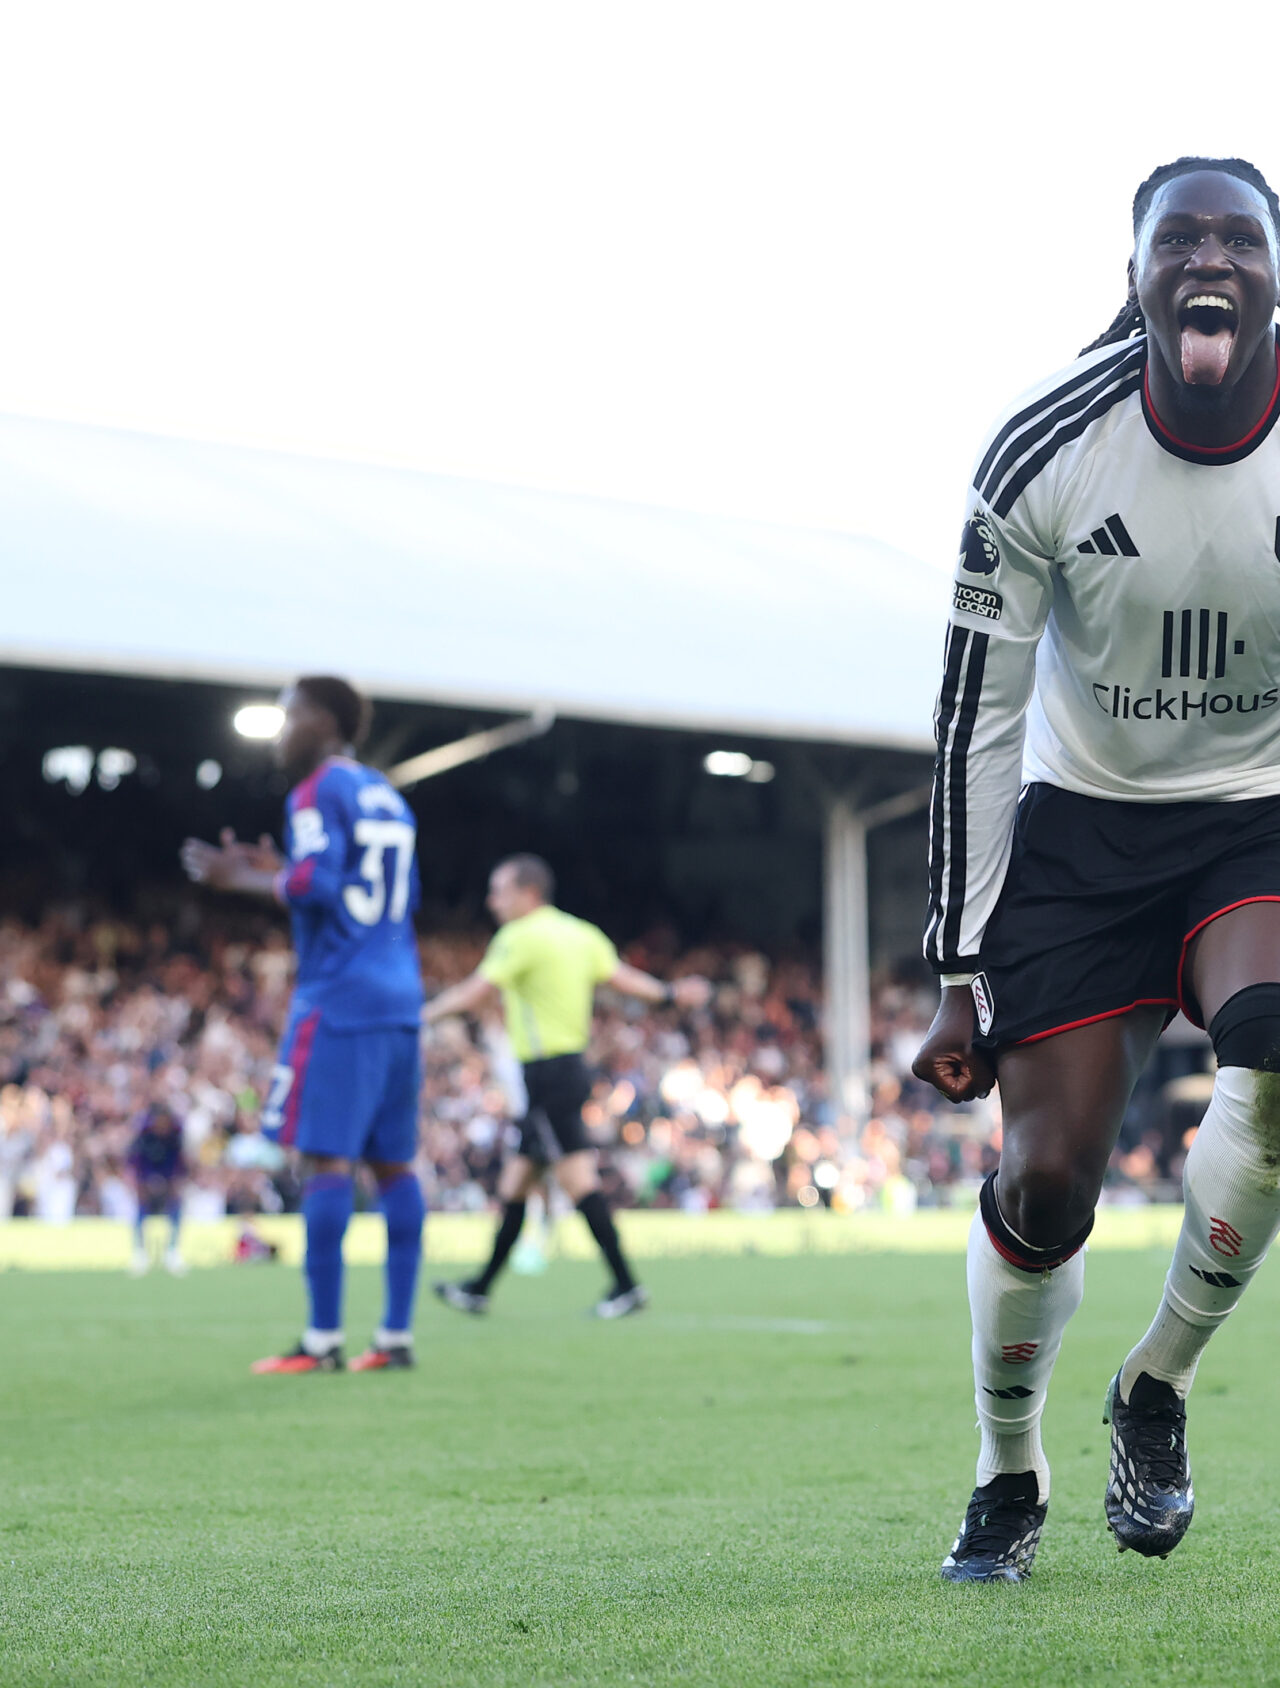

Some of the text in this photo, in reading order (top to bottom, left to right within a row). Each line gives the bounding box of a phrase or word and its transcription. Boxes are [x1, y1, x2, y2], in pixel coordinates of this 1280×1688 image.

[957, 586, 997, 606] room
[954, 597, 1001, 620] racism
[343, 818, 416, 926] 37
